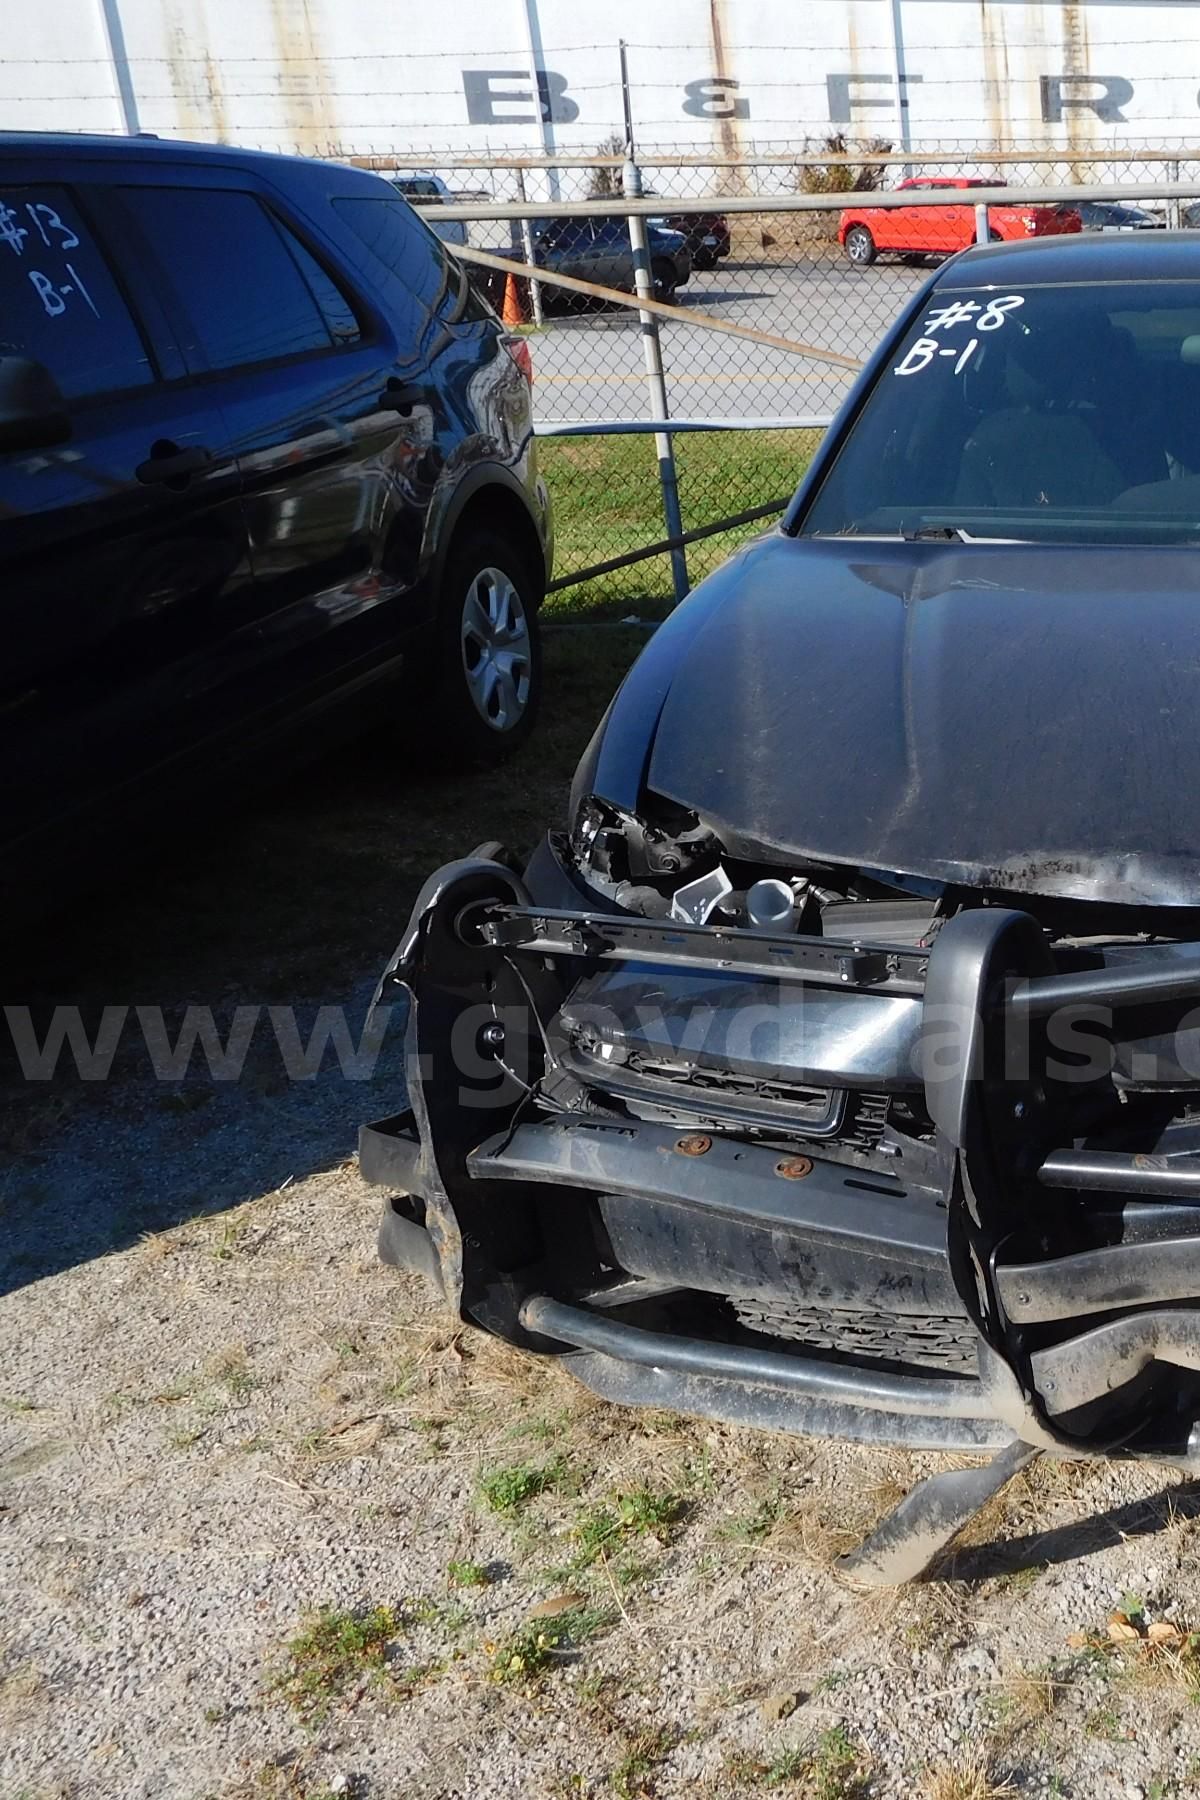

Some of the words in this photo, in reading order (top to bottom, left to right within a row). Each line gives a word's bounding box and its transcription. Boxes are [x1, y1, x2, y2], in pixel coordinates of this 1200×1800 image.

[28, 262, 101, 319] B-1
[923, 295, 1026, 336] #8
[894, 337, 979, 376] B-1
